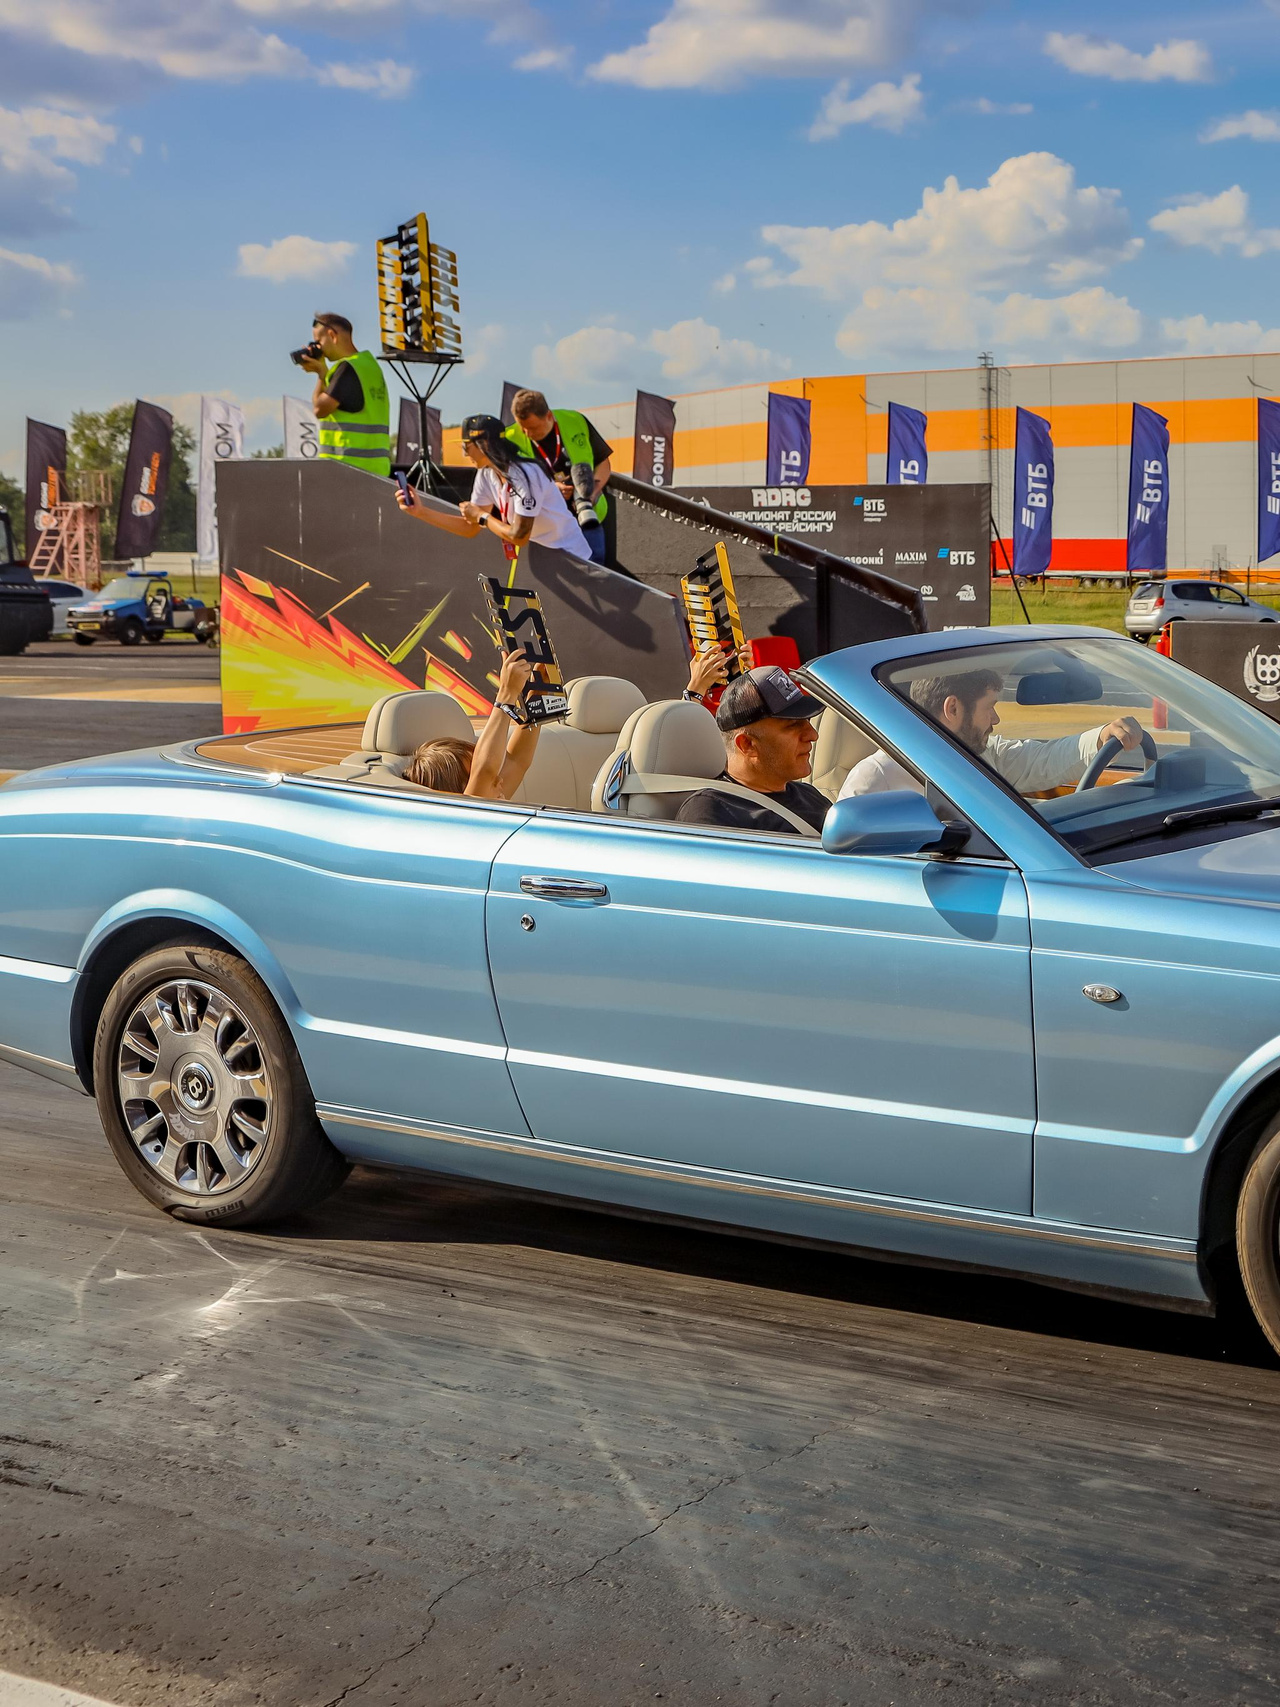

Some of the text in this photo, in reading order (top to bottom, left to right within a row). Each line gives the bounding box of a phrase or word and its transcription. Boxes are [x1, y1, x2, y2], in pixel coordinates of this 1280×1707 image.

[376, 240, 406, 350] ABSOLUT
[429, 243, 463, 354] TOP SPEED
[1028, 463, 1048, 508] ВТБ
[1142, 459, 1163, 502] ВТБ
[752, 488, 811, 507] RDRC
[863, 499, 885, 511] ВТБ
[794, 510, 836, 521] РОССИИ
[895, 552, 927, 561] MAXIM
[950, 551, 976, 565] ВТБ
[681, 577, 724, 666] SOLUT
